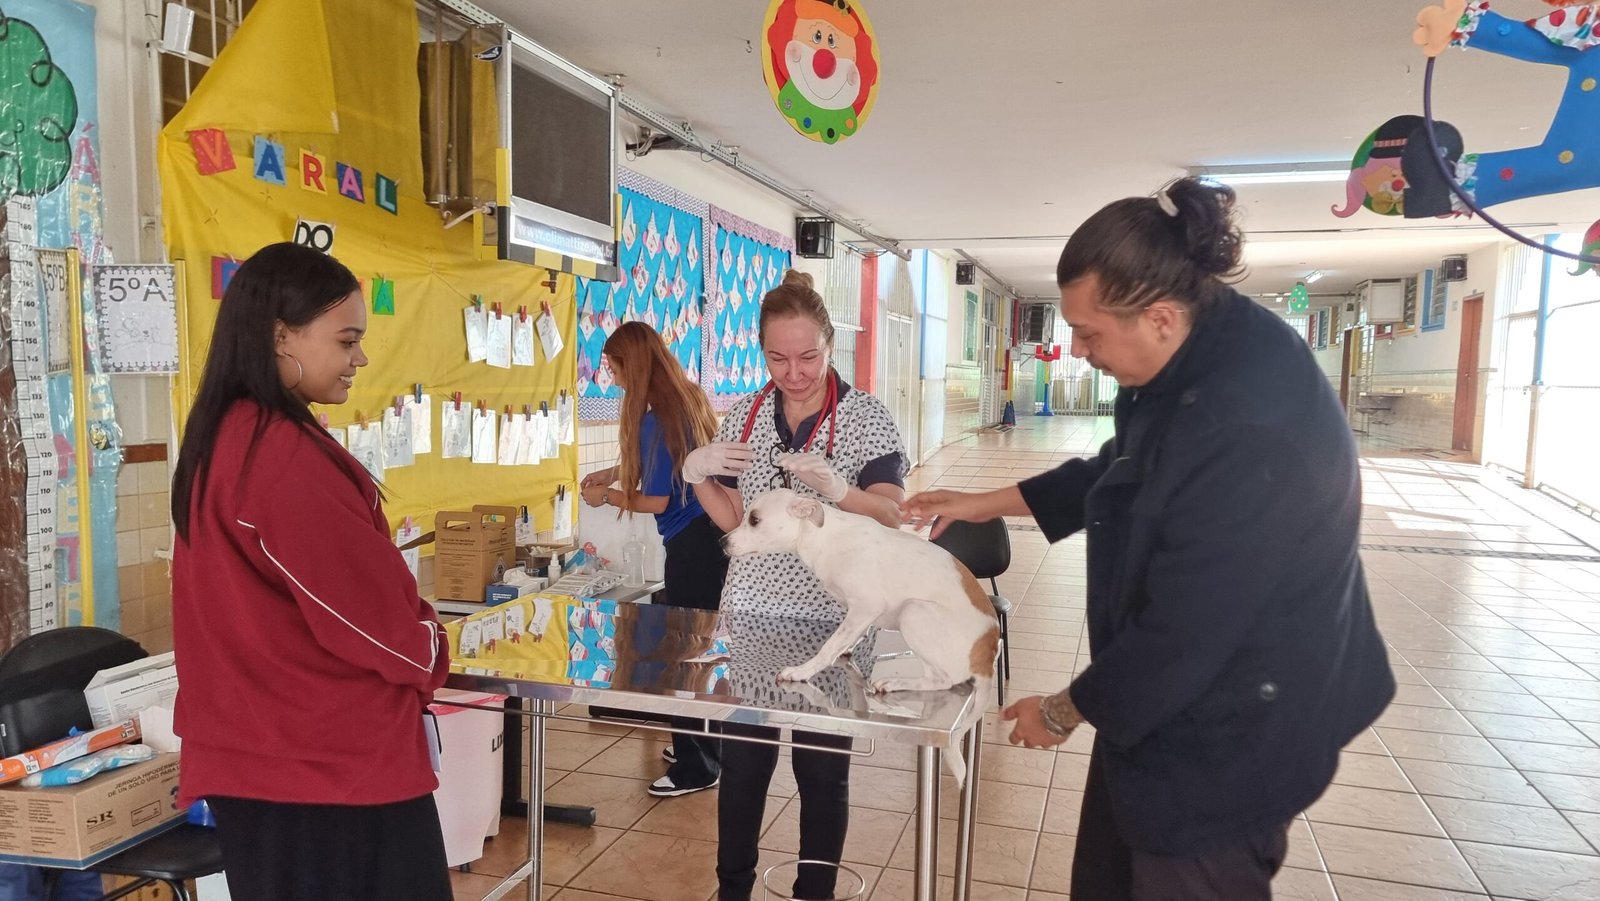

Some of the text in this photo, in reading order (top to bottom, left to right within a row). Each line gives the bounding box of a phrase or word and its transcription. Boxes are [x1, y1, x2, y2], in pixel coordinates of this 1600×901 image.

[197, 131, 397, 212] VARAL
[296, 221, 334, 253] DO
[25, 337, 38, 345] 150
[107, 790, 117, 799] DE
[118, 785, 128, 794] UN
[128, 778, 147, 790] SOLO
[146, 773, 160, 784] USO
[160, 766, 177, 778] PARA
[114, 775, 142, 790] JERINGA
[86, 810, 114, 825] SR
